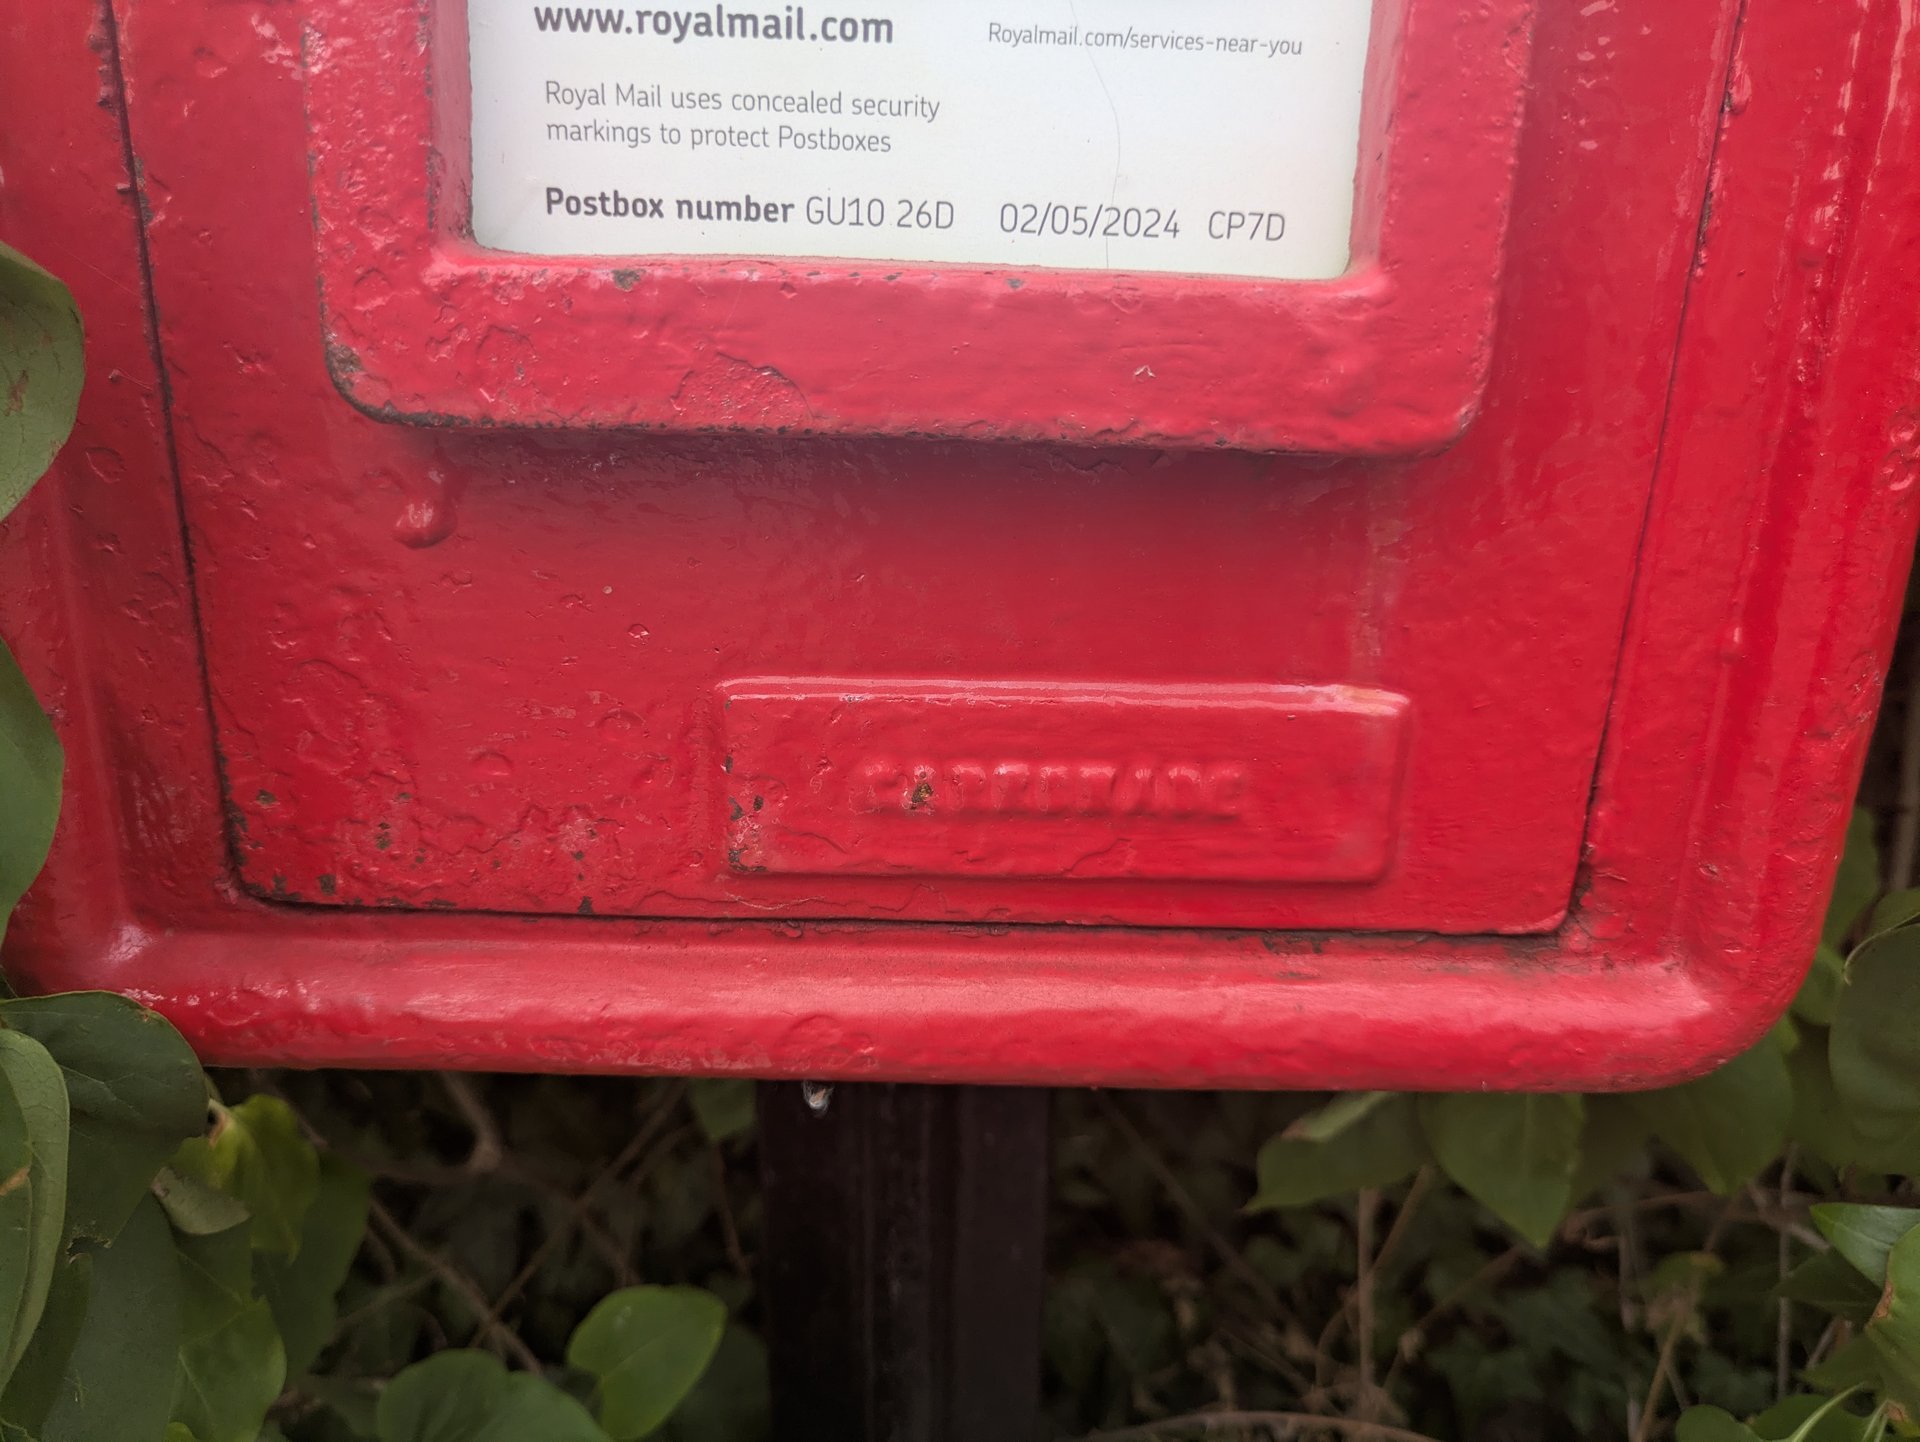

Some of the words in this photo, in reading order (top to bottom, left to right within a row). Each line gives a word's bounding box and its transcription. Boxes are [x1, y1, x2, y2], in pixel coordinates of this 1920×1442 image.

[533, 3, 894, 45] www.royalmail.com
[988, 21, 1303, 59] Royalmail.com/services-near-you
[545, 80, 607, 111] Royal
[615, 82, 662, 109] Mail
[671, 90, 723, 111] uses
[731, 89, 843, 115] concealed
[851, 95, 941, 124] security
[546, 117, 652, 151] markings
[659, 122, 682, 145] to
[690, 124, 770, 151] protect
[778, 124, 892, 153] Postboxes
[545, 186, 665, 221] Postbox
[675, 193, 796, 225] number
[805, 195, 886, 229] GU10
[896, 197, 955, 230] 26D
[999, 201, 1181, 239] 02/05/2024
[1208, 209, 1287, 243] CP7D
